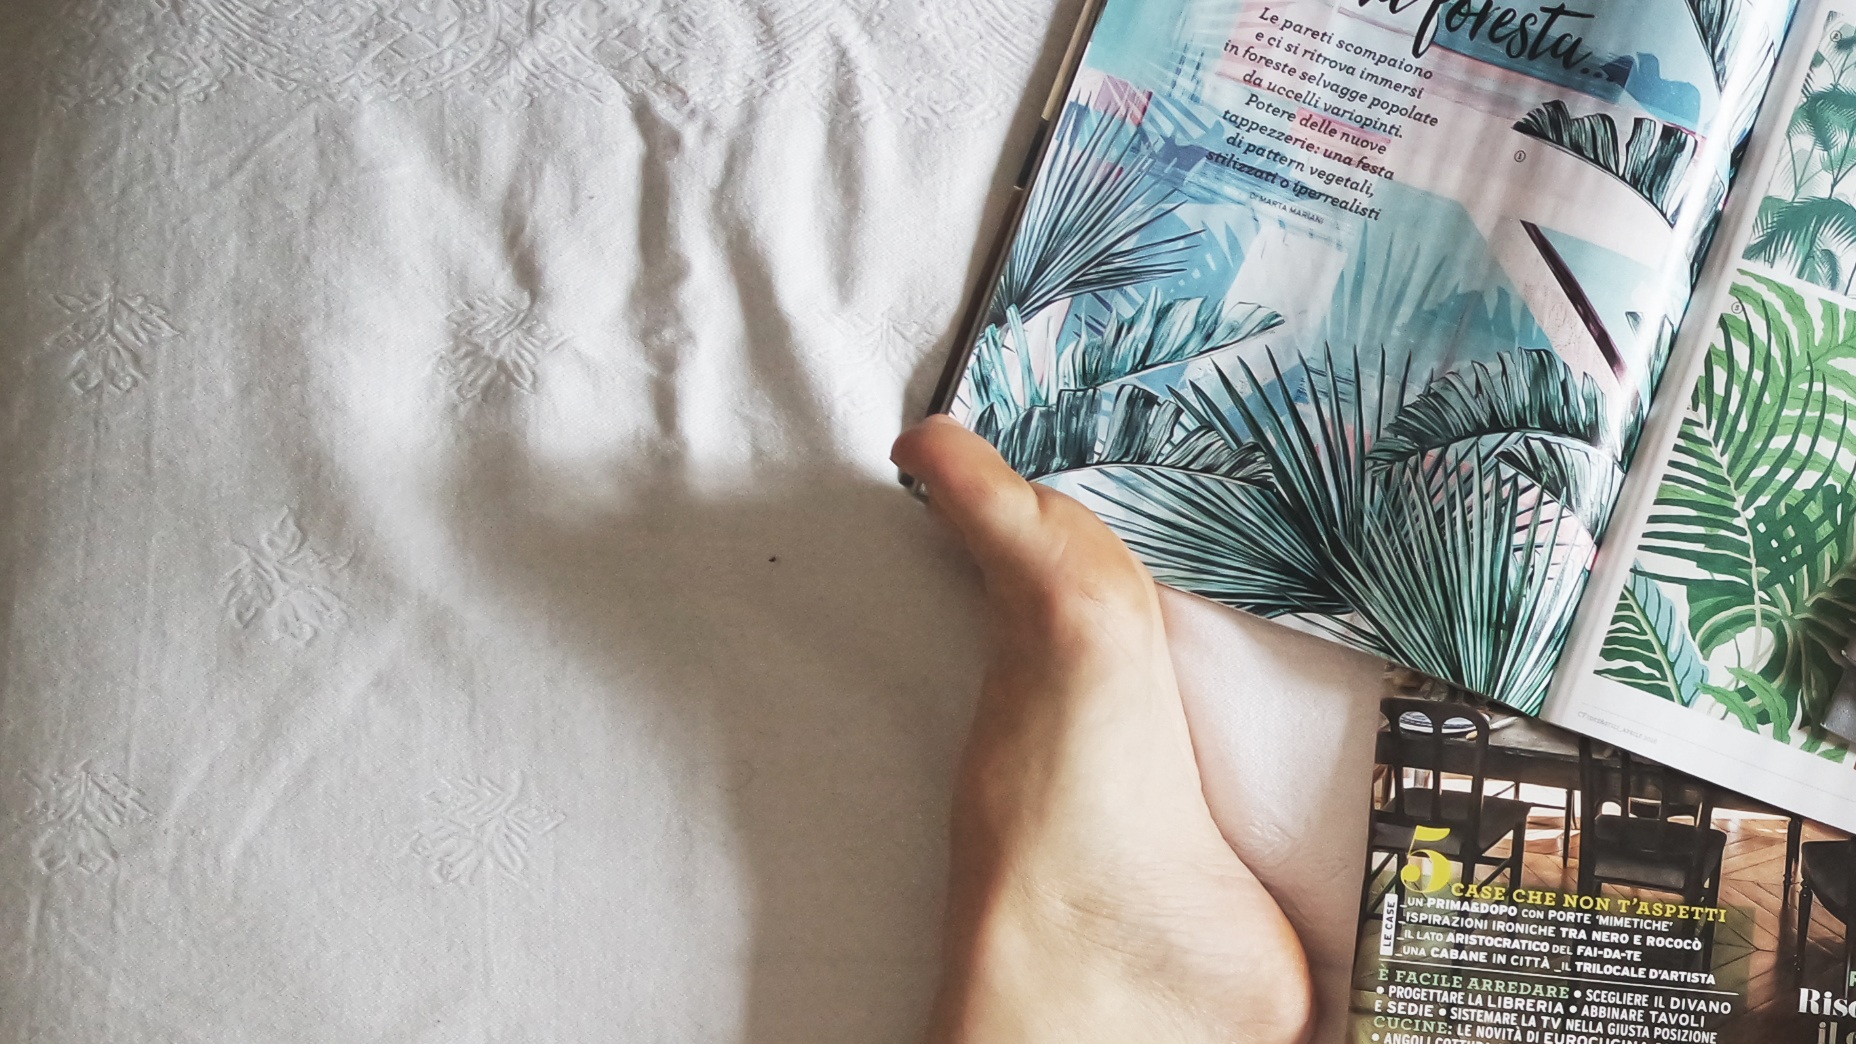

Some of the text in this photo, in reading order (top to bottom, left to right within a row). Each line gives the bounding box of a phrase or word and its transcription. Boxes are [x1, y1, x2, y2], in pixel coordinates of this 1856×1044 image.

[1259, 7, 1433, 79] Le pareti scompaiono
[1242, 46, 1439, 127] foreste selvagge popolate
[1302, 49, 1424, 99] ritrova immersi
[1243, 70, 1402, 138] da uccelli variopinti.
[1245, 94, 1386, 154] Potere delle nuove
[1222, 109, 1394, 180] tappezzerie: una festa
[1206, 151, 1381, 221] stilizzati iperrealisti
[1243, 143, 1375, 198] pattern vegetali,
[1260, 196, 1324, 225] MARTA MARIANI
[1400, 825, 1452, 893] 5
[1383, 900, 1395, 946] LE CASE
[1427, 897, 1517, 916] PRIMA&DOPO
[1522, 909, 1544, 919] CON
[1548, 910, 1591, 924] PORTE
[1451, 883, 1727, 923] CASE CHE NON T'ASPETTI
[1417, 931, 1642, 961] LATO ARISTOCRATICO FAI-DA-TE
[1492, 920, 1556, 937] IRONICHE
[1560, 927, 1587, 940] TRA
[1592, 931, 1629, 944] NERO
[1646, 936, 1702, 950] ROCOCÒ
[1378, 964, 1731, 1015] È FACILE ARREDARE SCEGLIERE IL DIVANO
[1431, 947, 1716, 985] CABANE CITTÀ TRILOCALE D'ARTISTA
[1373, 1016, 1452, 1035] CUCINE:
[1476, 1026, 1522, 1042] NOVITÀ
[1387, 1000, 1717, 1044] SEDIE SISTEMARE TV NELLA GIUSTA POSIZIONE
[1388, 985, 1705, 1028] PROGETTARE LIBRERIA ABBINARE TAVOLI
